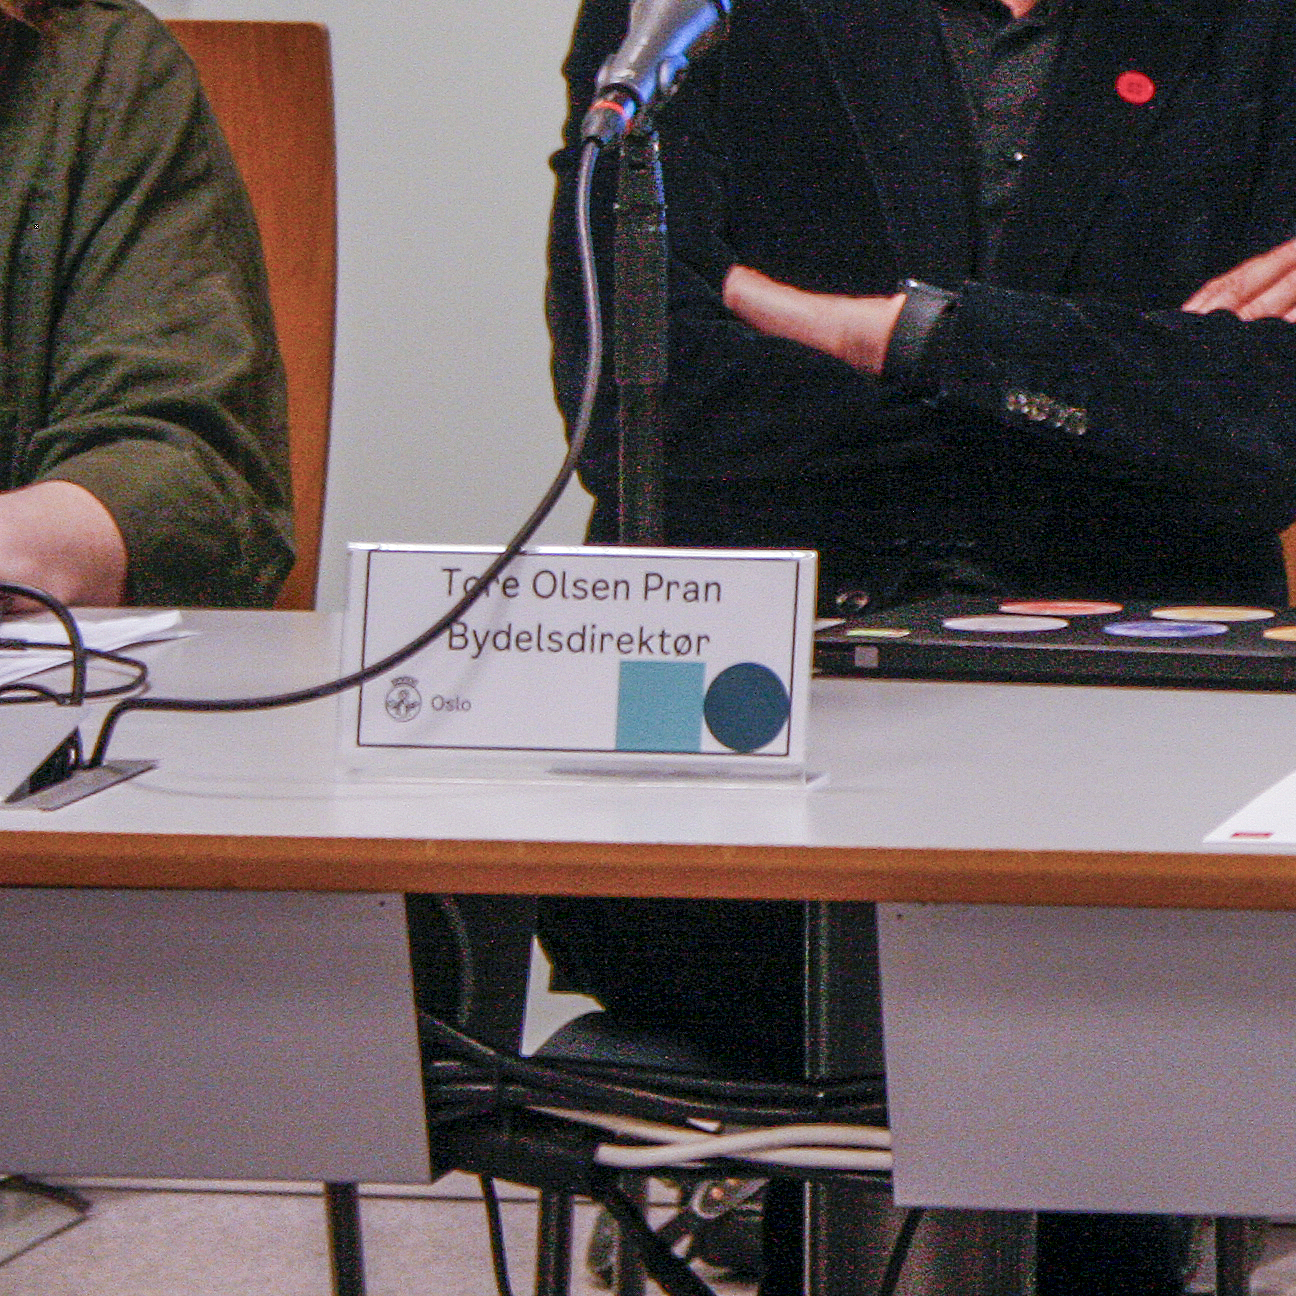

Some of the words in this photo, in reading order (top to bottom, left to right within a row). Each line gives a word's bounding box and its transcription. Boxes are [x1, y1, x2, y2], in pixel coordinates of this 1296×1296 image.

[532, 569, 630, 601] Olsen
[643, 573, 722, 603] Pran
[447, 622, 711, 659] Bydelsdirektør
[431, 695, 472, 712] Oslo
